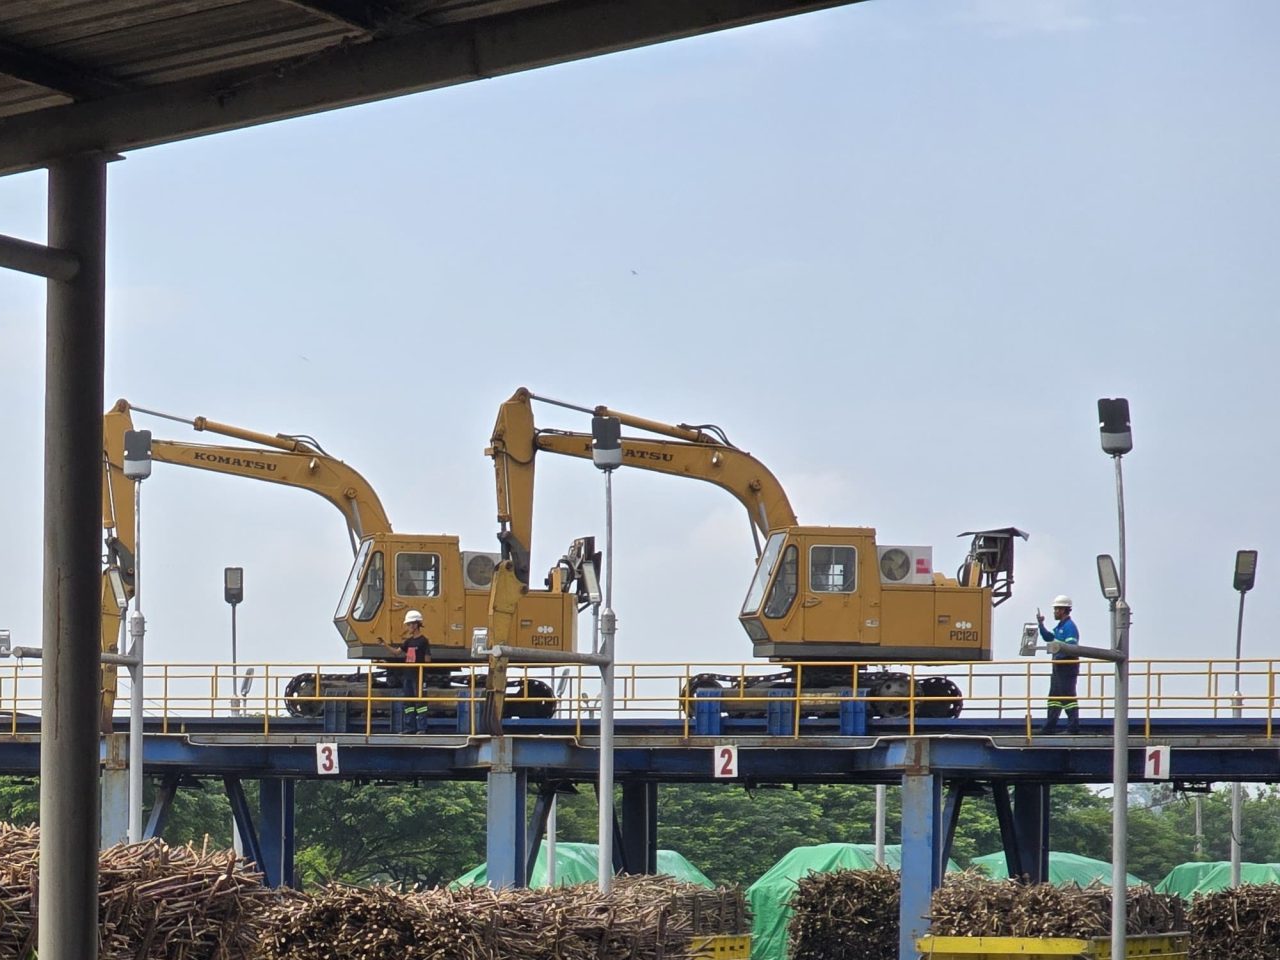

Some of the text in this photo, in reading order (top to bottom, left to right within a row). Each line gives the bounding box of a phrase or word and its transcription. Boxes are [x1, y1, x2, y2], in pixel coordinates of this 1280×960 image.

[194, 452, 277, 471] KOMATSU
[584, 443, 674, 462] KATSU
[531, 635, 560, 646] PC120
[949, 630, 979, 641] PC120
[321, 746, 334, 772] 3
[720, 748, 733, 775] 2
[1148, 749, 1161, 776] 1
